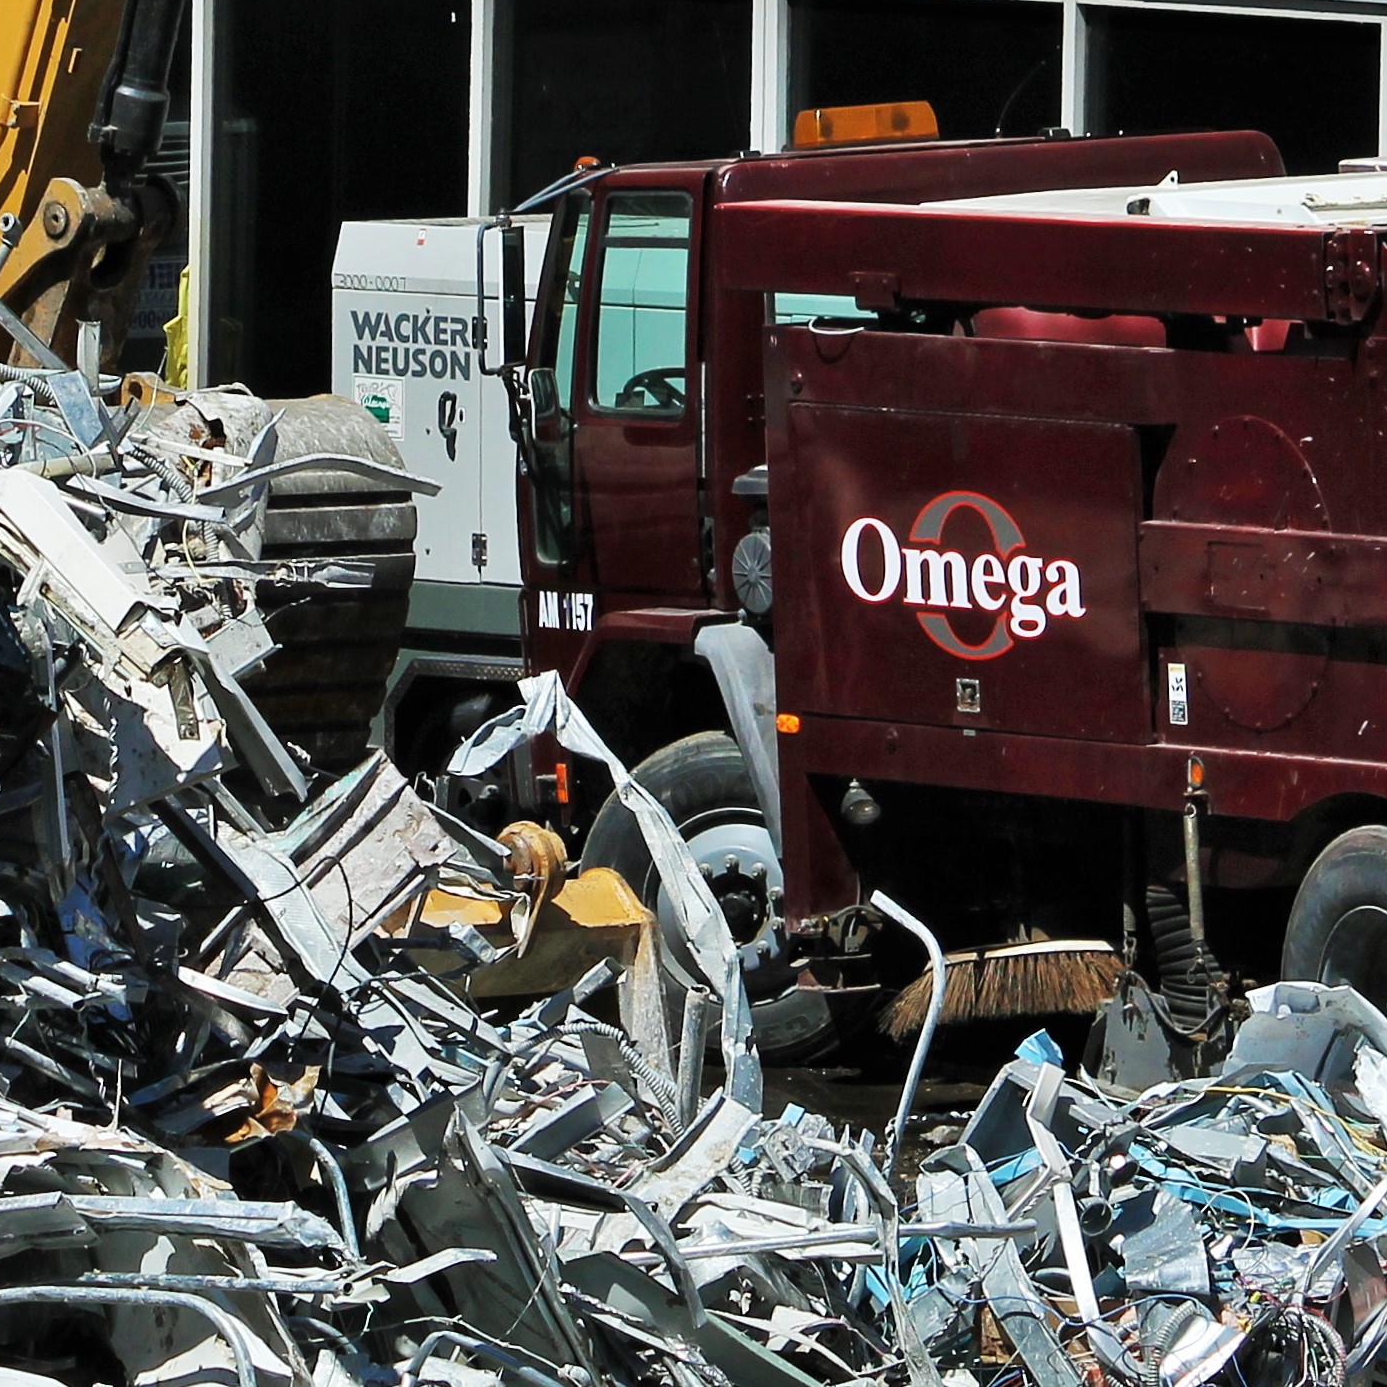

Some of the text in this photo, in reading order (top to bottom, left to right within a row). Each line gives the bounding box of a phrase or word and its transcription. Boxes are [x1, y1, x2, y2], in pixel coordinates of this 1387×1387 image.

[350, 310, 469, 349] WACKER
[352, 343, 472, 382] NEUSON
[840, 517, 1087, 639] Omega
[538, 590, 594, 632] AM 1157
